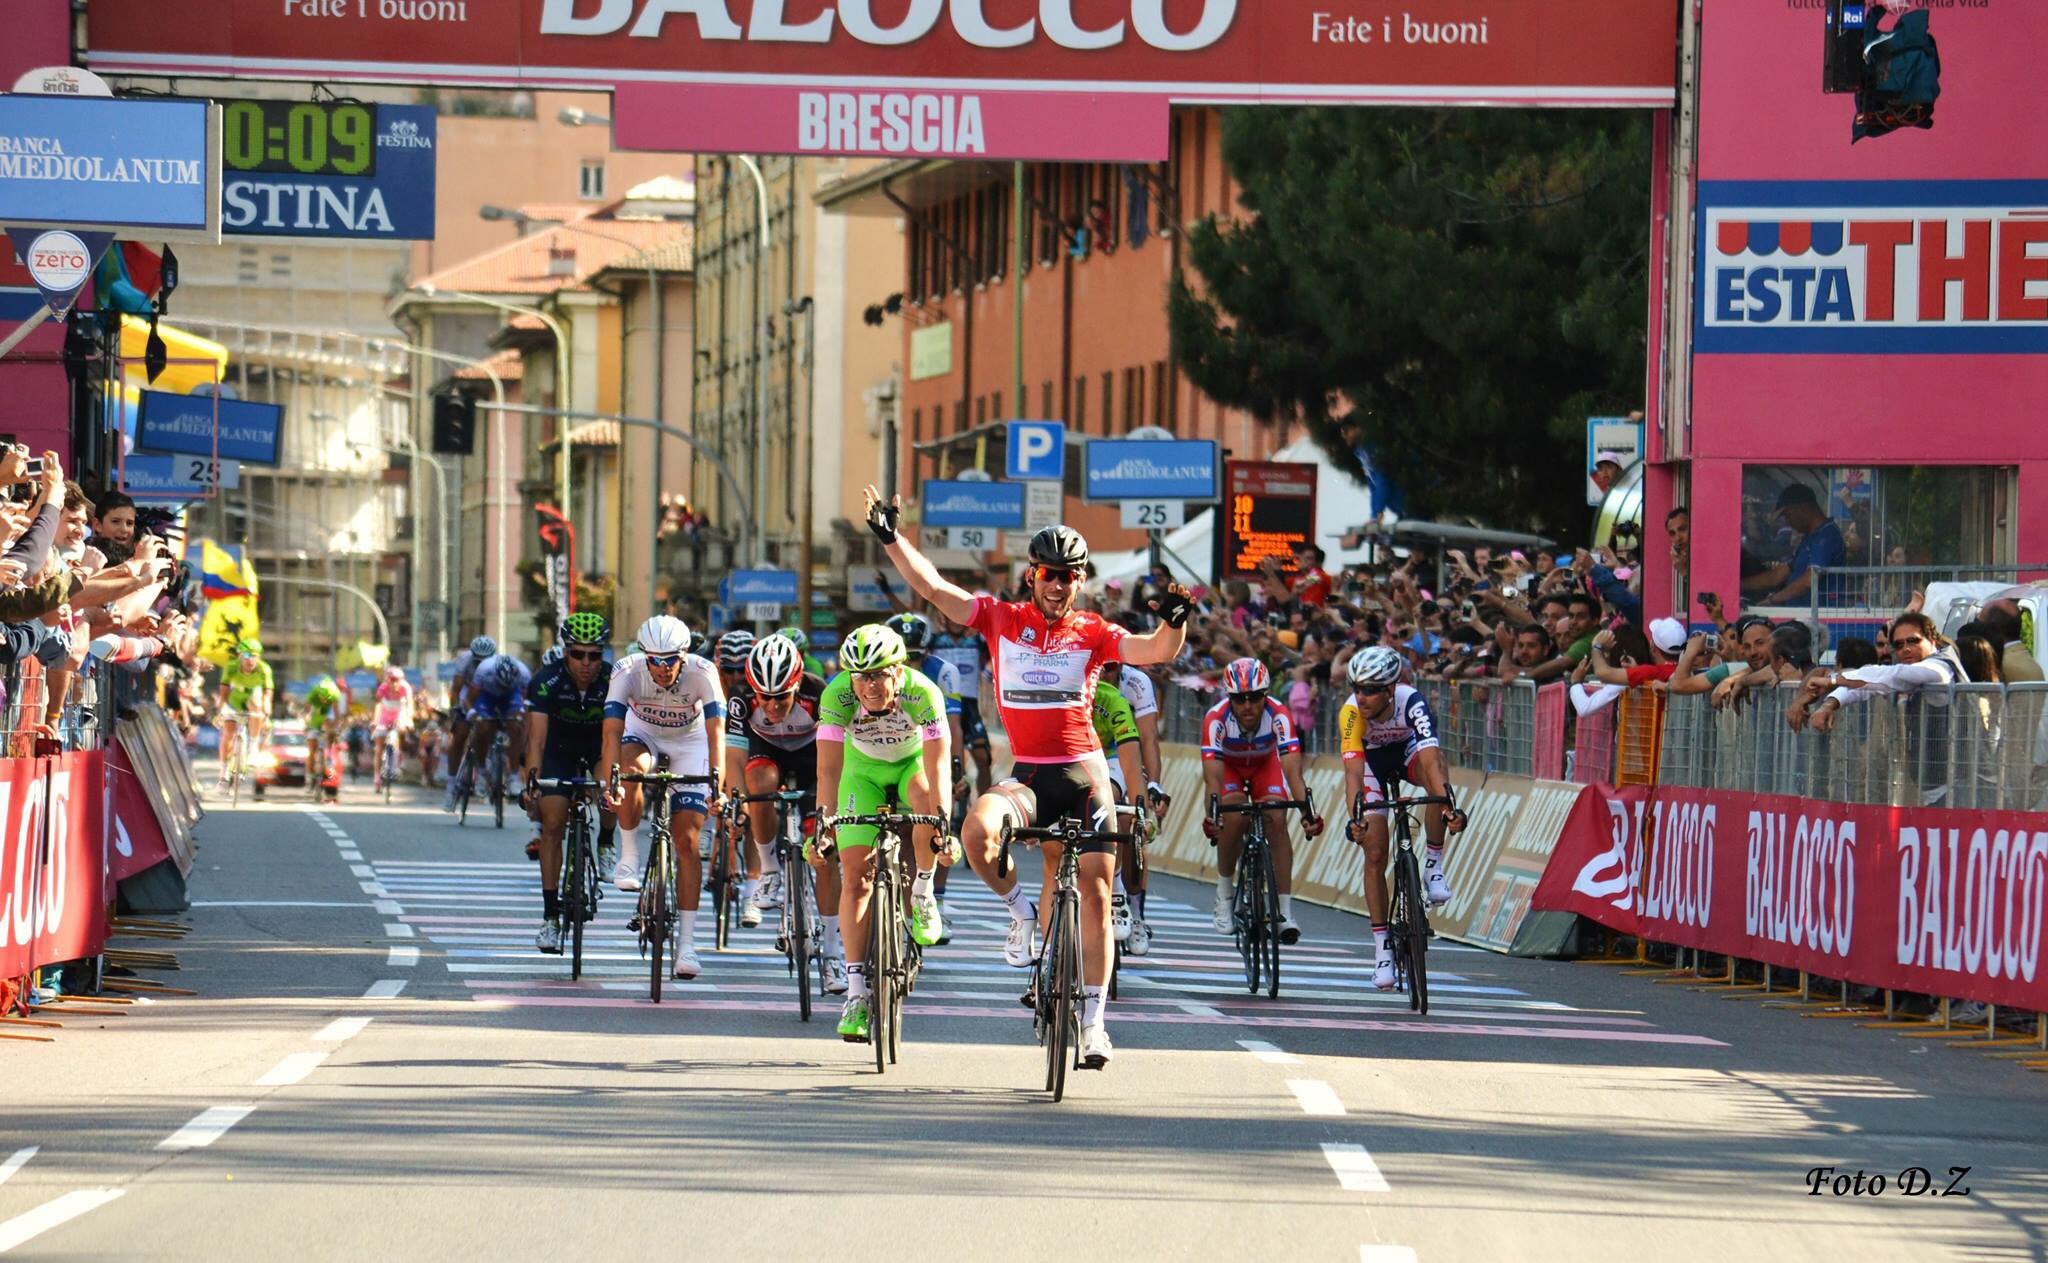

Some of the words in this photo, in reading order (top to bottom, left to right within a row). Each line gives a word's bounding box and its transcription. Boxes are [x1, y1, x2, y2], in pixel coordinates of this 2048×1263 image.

[379, 0, 468, 22] buoni
[1843, 11, 1863, 24] Rai
[1311, 12, 1372, 43] Fate
[1382, 16, 1392, 43] i
[1402, 12, 1488, 44] buoni
[798, 92, 986, 153] BRESCIA
[0, 136, 64, 155] BANCA
[225, 101, 370, 175] 0:09
[377, 134, 432, 149] FESTINA
[0, 154, 200, 185] MEDIOLANUM
[222, 181, 395, 232] STINA
[35, 253, 84, 269] zero
[1018, 426, 1053, 473] P
[189, 460, 221, 483] 25
[1121, 464, 1211, 480] MEDIOLANUM
[1138, 504, 1167, 525] 25
[961, 530, 984, 547] 50
[752, 604, 775, 617] 100
[1572, 800, 1717, 928] BALOCCO
[1746, 810, 1857, 958] BALOCCO
[1897, 826, 2048, 983] BALOCCO
